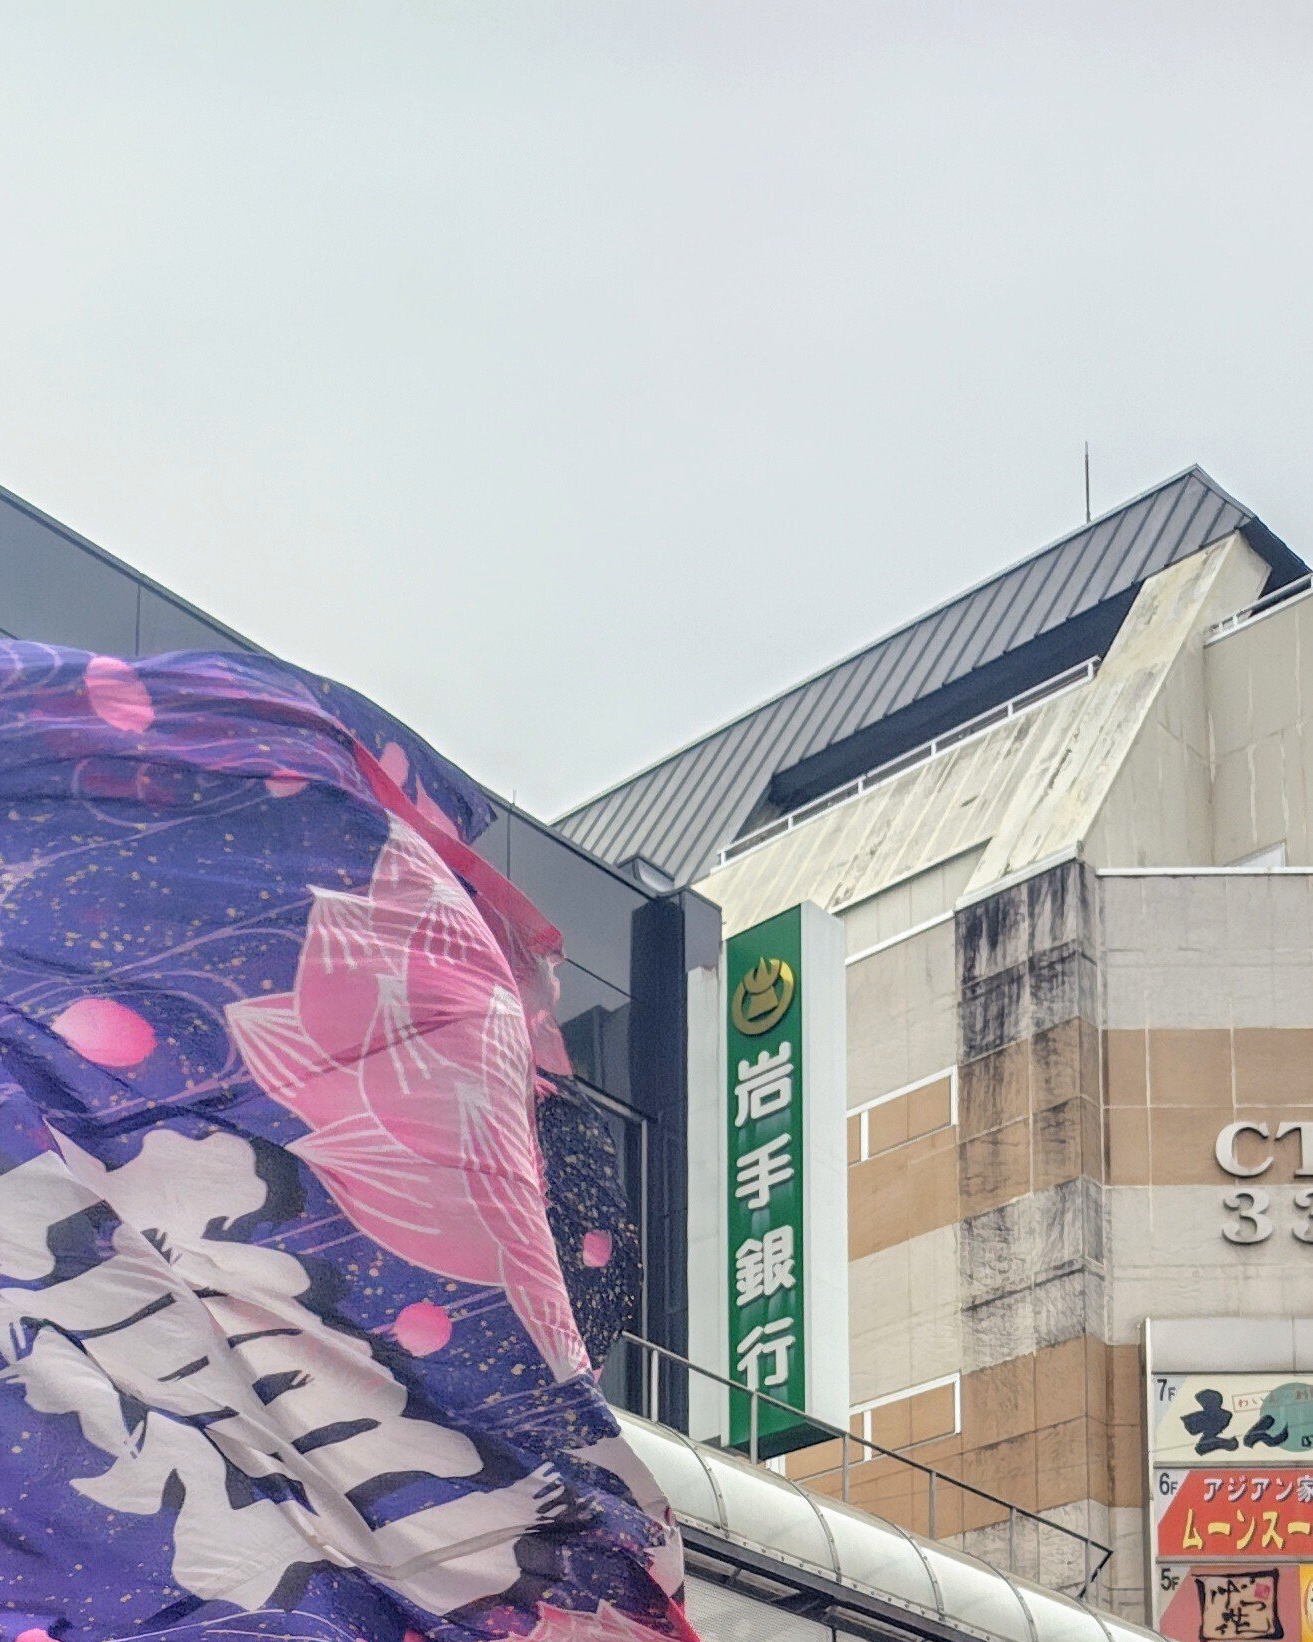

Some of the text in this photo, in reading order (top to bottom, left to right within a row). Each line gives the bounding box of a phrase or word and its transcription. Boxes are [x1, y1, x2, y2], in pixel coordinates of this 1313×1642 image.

[733, 1040, 796, 1391] 岩手銀行
[1157, 1378, 1177, 1402] 7F
[1159, 1472, 1179, 1496] 6F
[1202, 1474, 1313, 1503] アジアン家
[1182, 1508, 1312, 1550] ムーンスー
[1160, 1567, 1181, 1591] 5F
